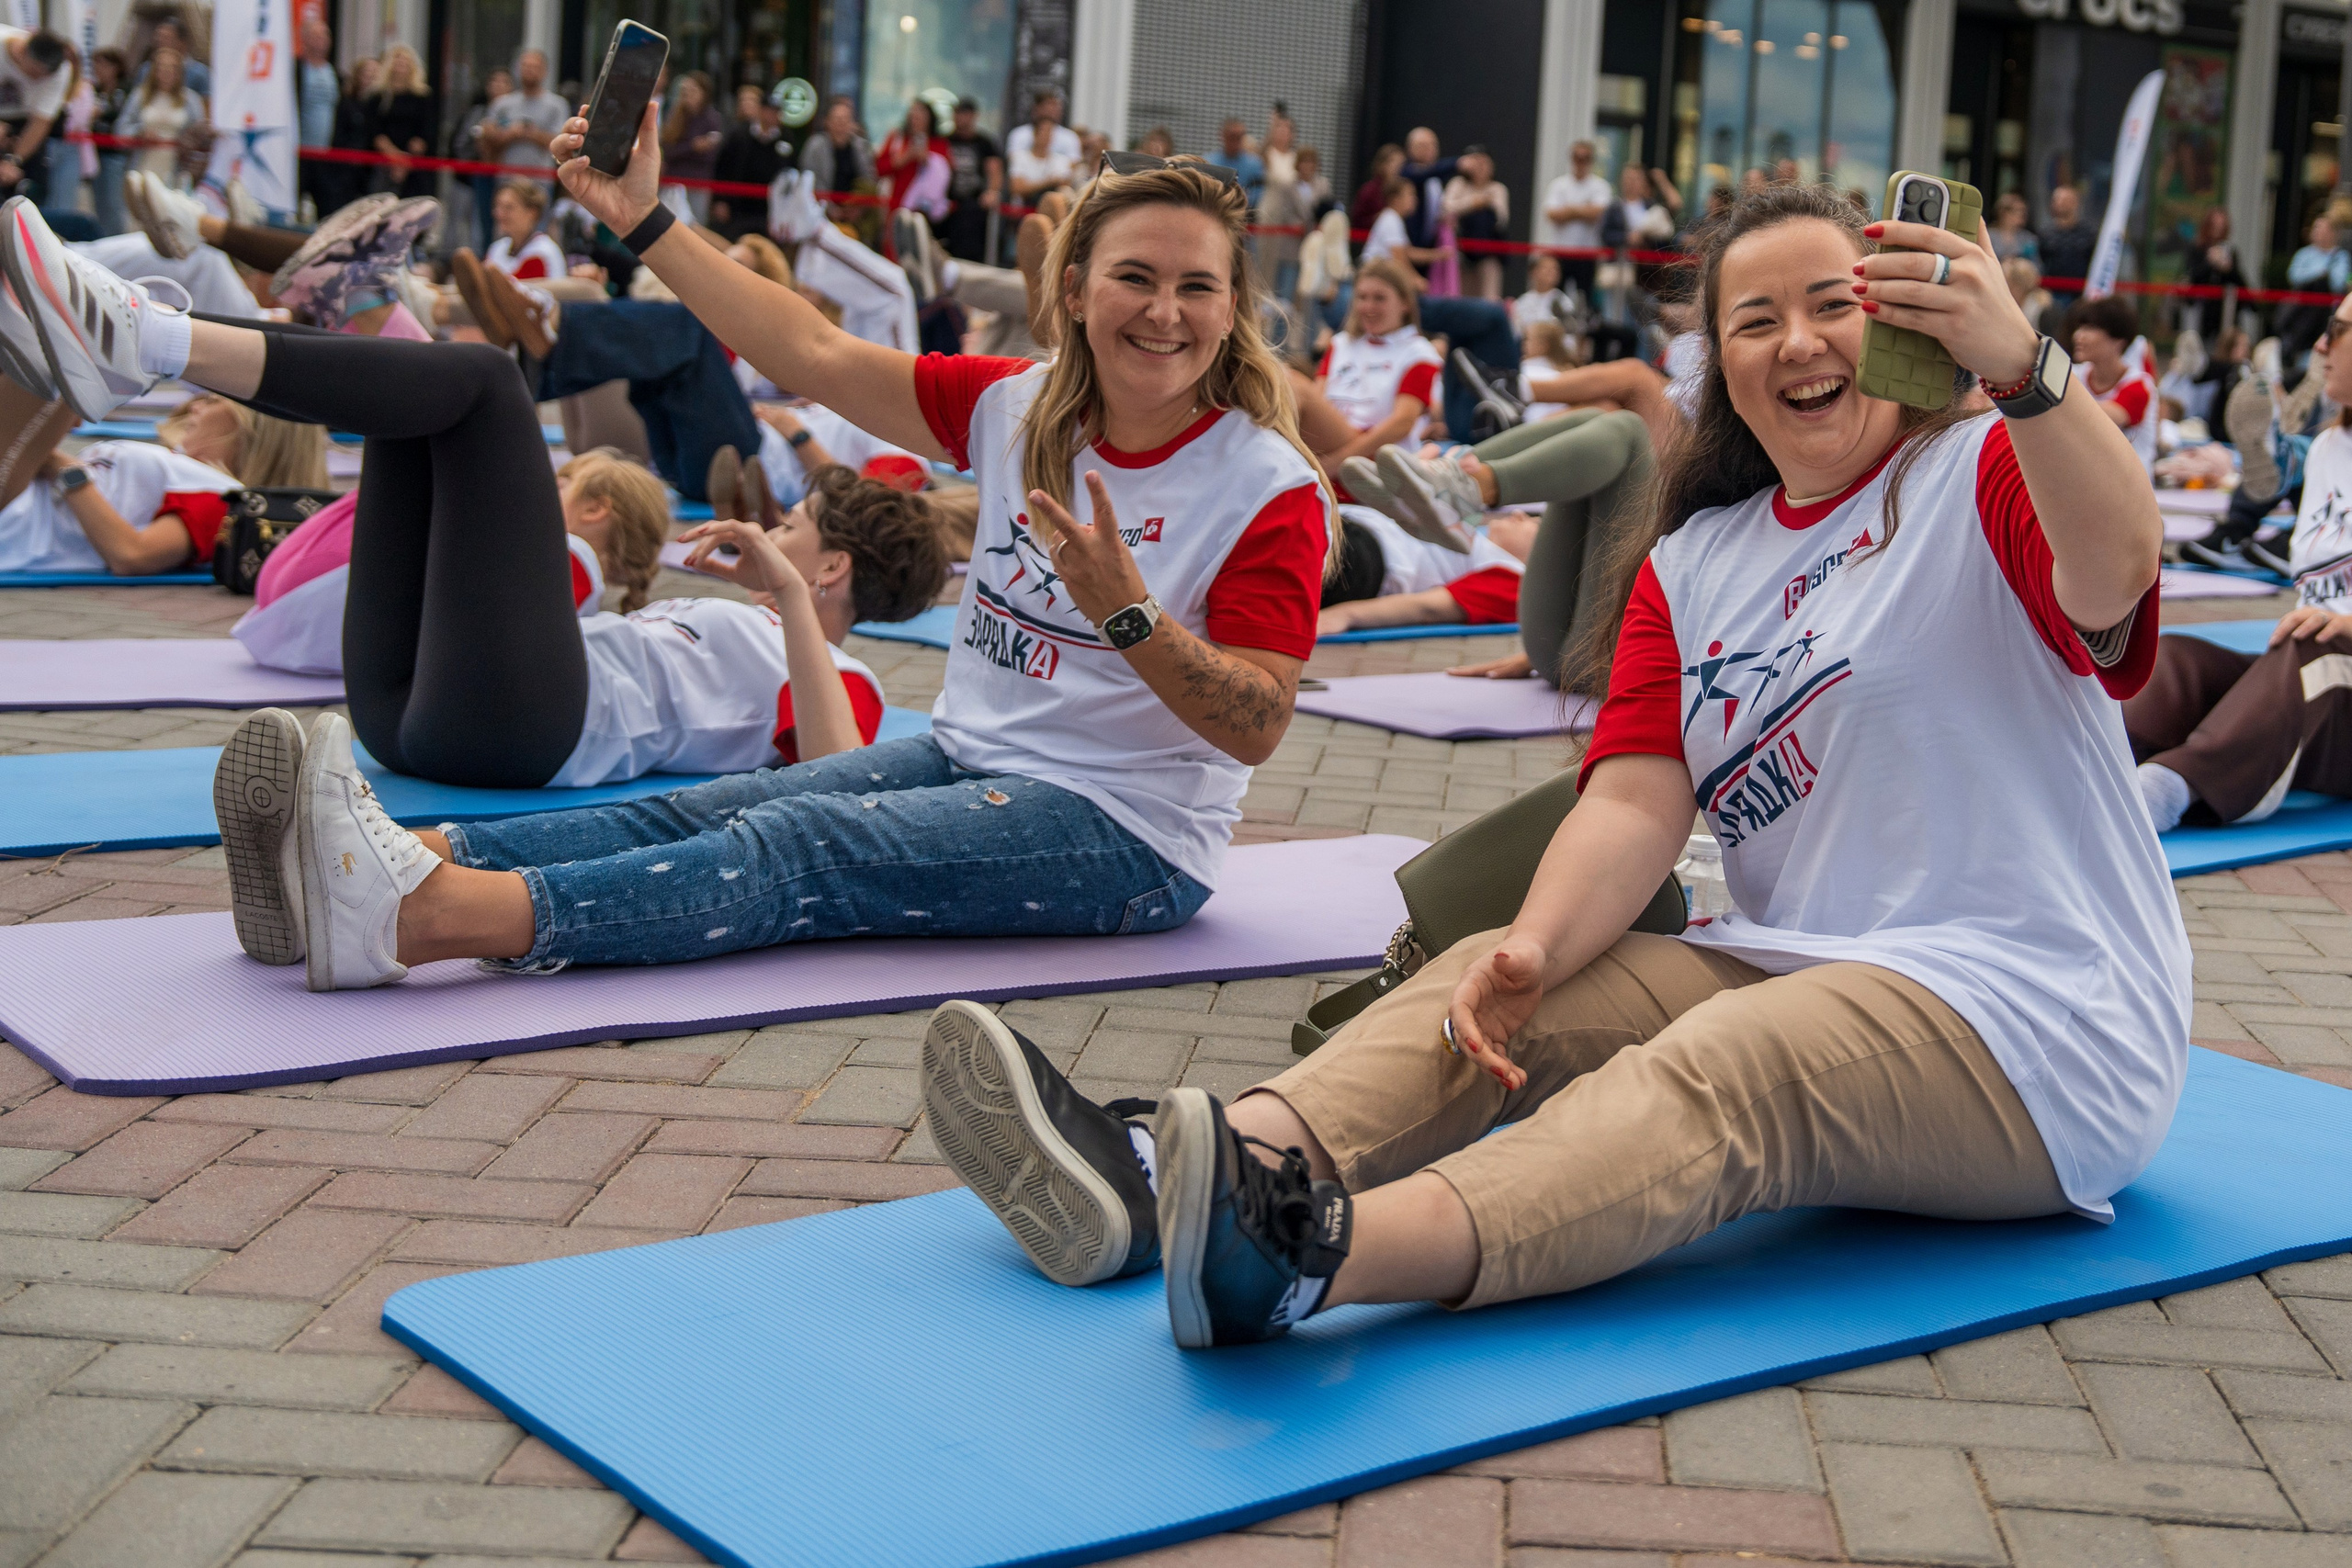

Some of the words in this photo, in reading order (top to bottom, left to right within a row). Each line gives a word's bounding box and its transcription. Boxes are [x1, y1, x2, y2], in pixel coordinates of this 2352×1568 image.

[964, 604, 1060, 681] ЗАРЯДКА
[1718, 729, 1820, 848] РЯДКА
[244, 910, 279, 921] LACOSTE
[1328, 1197, 1344, 1243] PRADA
